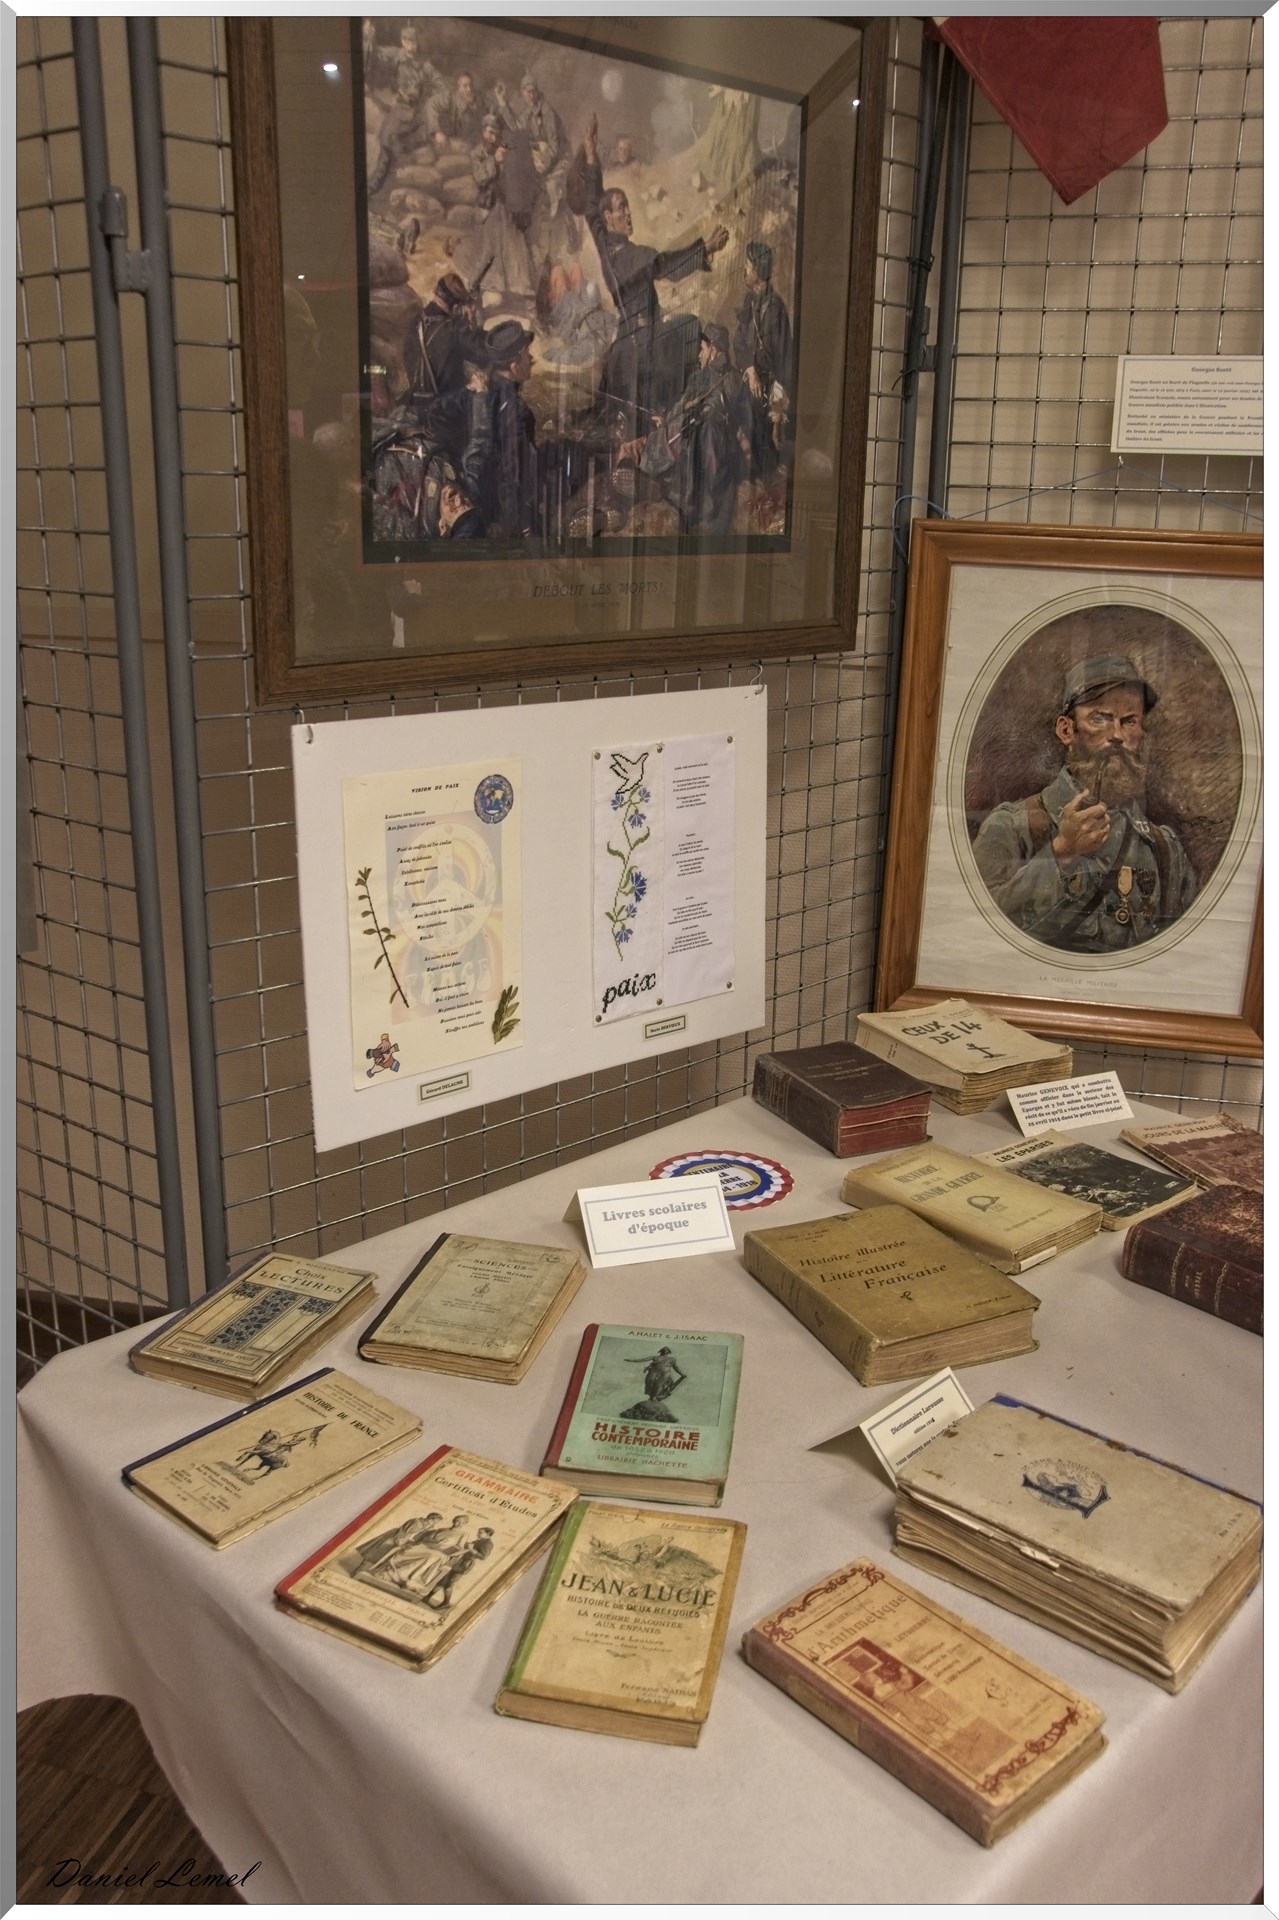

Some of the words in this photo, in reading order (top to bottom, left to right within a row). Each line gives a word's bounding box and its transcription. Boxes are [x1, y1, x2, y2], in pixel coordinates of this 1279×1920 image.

[533, 584, 584, 598] DEBOUT
[591, 584, 611, 596] LES
[602, 972, 657, 1014] paix
[901, 1020, 946, 1037] CEUX
[929, 1031, 961, 1045] DE
[951, 1020, 983, 1035] 14
[1016, 1091, 1037, 1099] Maurice
[1040, 1085, 1069, 1095] GENEVOIX
[1088, 1078, 1111, 1086] combattu
[1040, 1095, 1059, 1103] officier
[1094, 1099, 1112, 1108] janvier
[1035, 1117, 1048, 1126] avril
[1061, 1113, 1073, 1121] dans
[1079, 1110, 1092, 1118] petit
[1092, 1107, 1104, 1115] livre
[1105, 1105, 1123, 1114] ci-joint
[683, 1163, 735, 1176] ENTENAIRE
[893, 1164, 941, 1184] HISTOIRE
[736, 1180, 758, 1188] 1918
[911, 1184, 949, 1203] GRANDE
[948, 1171, 985, 1190] GUERRE
[602, 1208, 645, 1222] Livres
[649, 1200, 707, 1217] scolaires
[628, 1219, 689, 1235] d'époque
[800, 1253, 851, 1267] Histoire
[857, 1239, 906, 1257] illustrée
[295, 1268, 328, 1280] Choix
[474, 1258, 527, 1271] SCIENCES
[819, 1259, 908, 1283] Littérature
[258, 1270, 345, 1294] LECTURES
[864, 1263, 948, 1290] Française
[302, 1391, 335, 1413] HISTOIRE
[336, 1410, 351, 1422] DE
[349, 1417, 382, 1439] FRANCE
[890, 1411, 923, 1435] Dictionnaire
[921, 1396, 944, 1414] Larousse
[591, 1432, 698, 1451] CONTEMPORAINE
[594, 1422, 700, 1441] HISTOIRE
[597, 1455, 638, 1464] LIBRAIRIE
[642, 1459, 688, 1469] HACHETTE
[434, 1475, 486, 1501] Certificat
[490, 1495, 538, 1518] d'Études
[454, 1468, 540, 1505] GRAMMAIRE
[561, 1573, 624, 1598] JEAN
[628, 1587, 638, 1598] &
[644, 1583, 717, 1607] LUCIE
[567, 1595, 610, 1608] HISTOIRE
[612, 1602, 625, 1611] DE
[626, 1603, 652, 1615] DEUX
[577, 1609, 589, 1617] LA
[593, 1612, 630, 1623] GUERRE
[595, 1620, 616, 1630] AUX
[619, 1623, 661, 1635] ENFANTS
[585, 1630, 610, 1639] Livre
[614, 1633, 625, 1641] de
[628, 1634, 664, 1646] Lecture
[620, 1682, 659, 1693] Fernand
[662, 1687, 697, 1697] NATHAN
